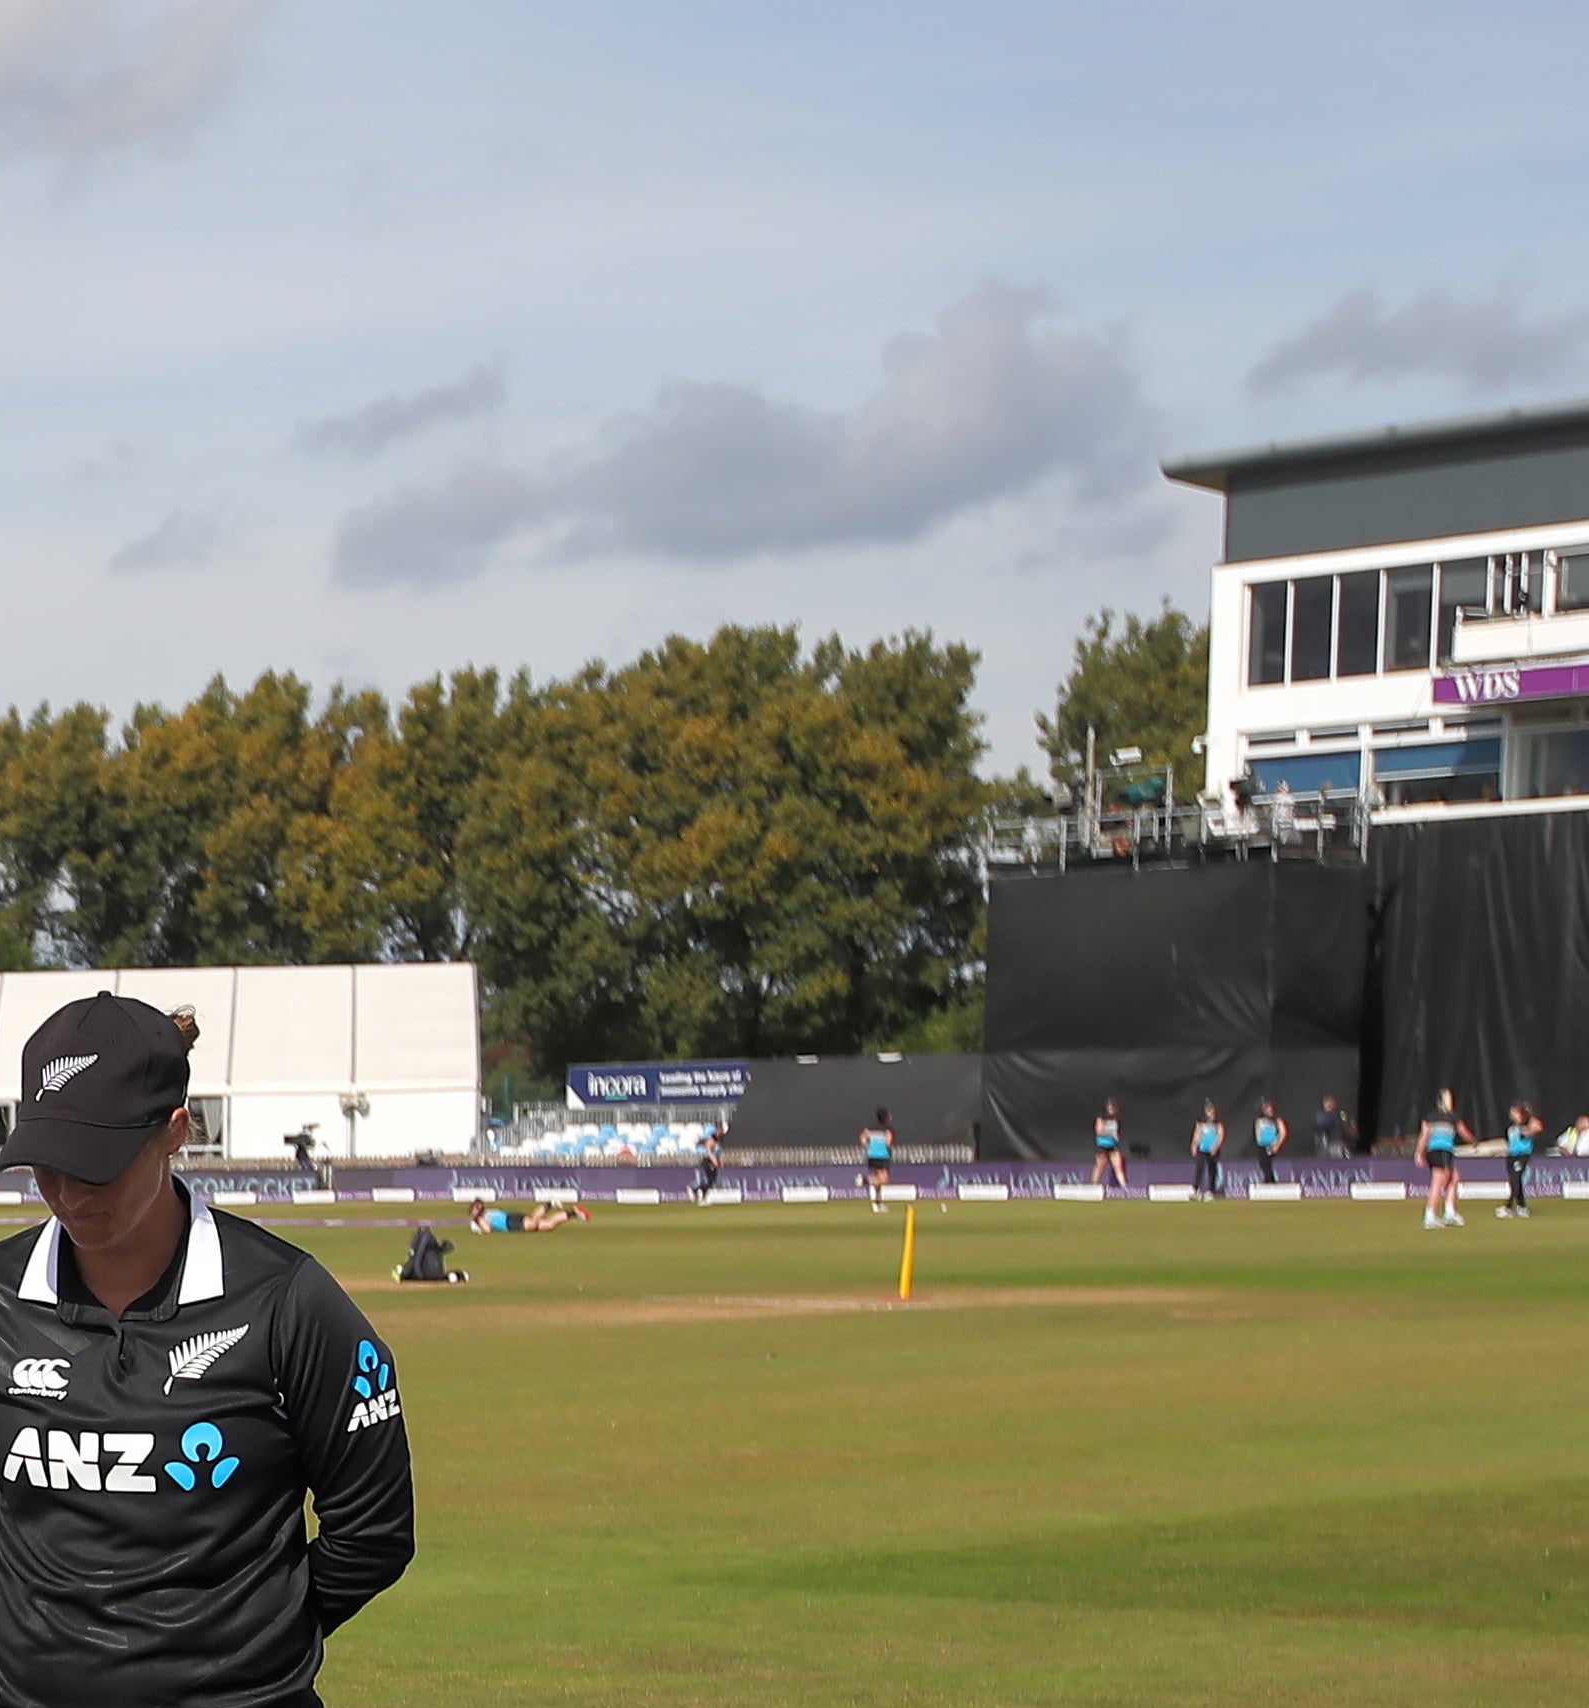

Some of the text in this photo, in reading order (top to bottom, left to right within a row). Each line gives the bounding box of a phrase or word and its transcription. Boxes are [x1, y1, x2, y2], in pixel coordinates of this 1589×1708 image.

[1454, 669, 1520, 702] WDS
[7, 1387, 68, 1400] canterbury
[347, 1388, 401, 1433] ANZ
[3, 1426, 157, 1493] ANZ
